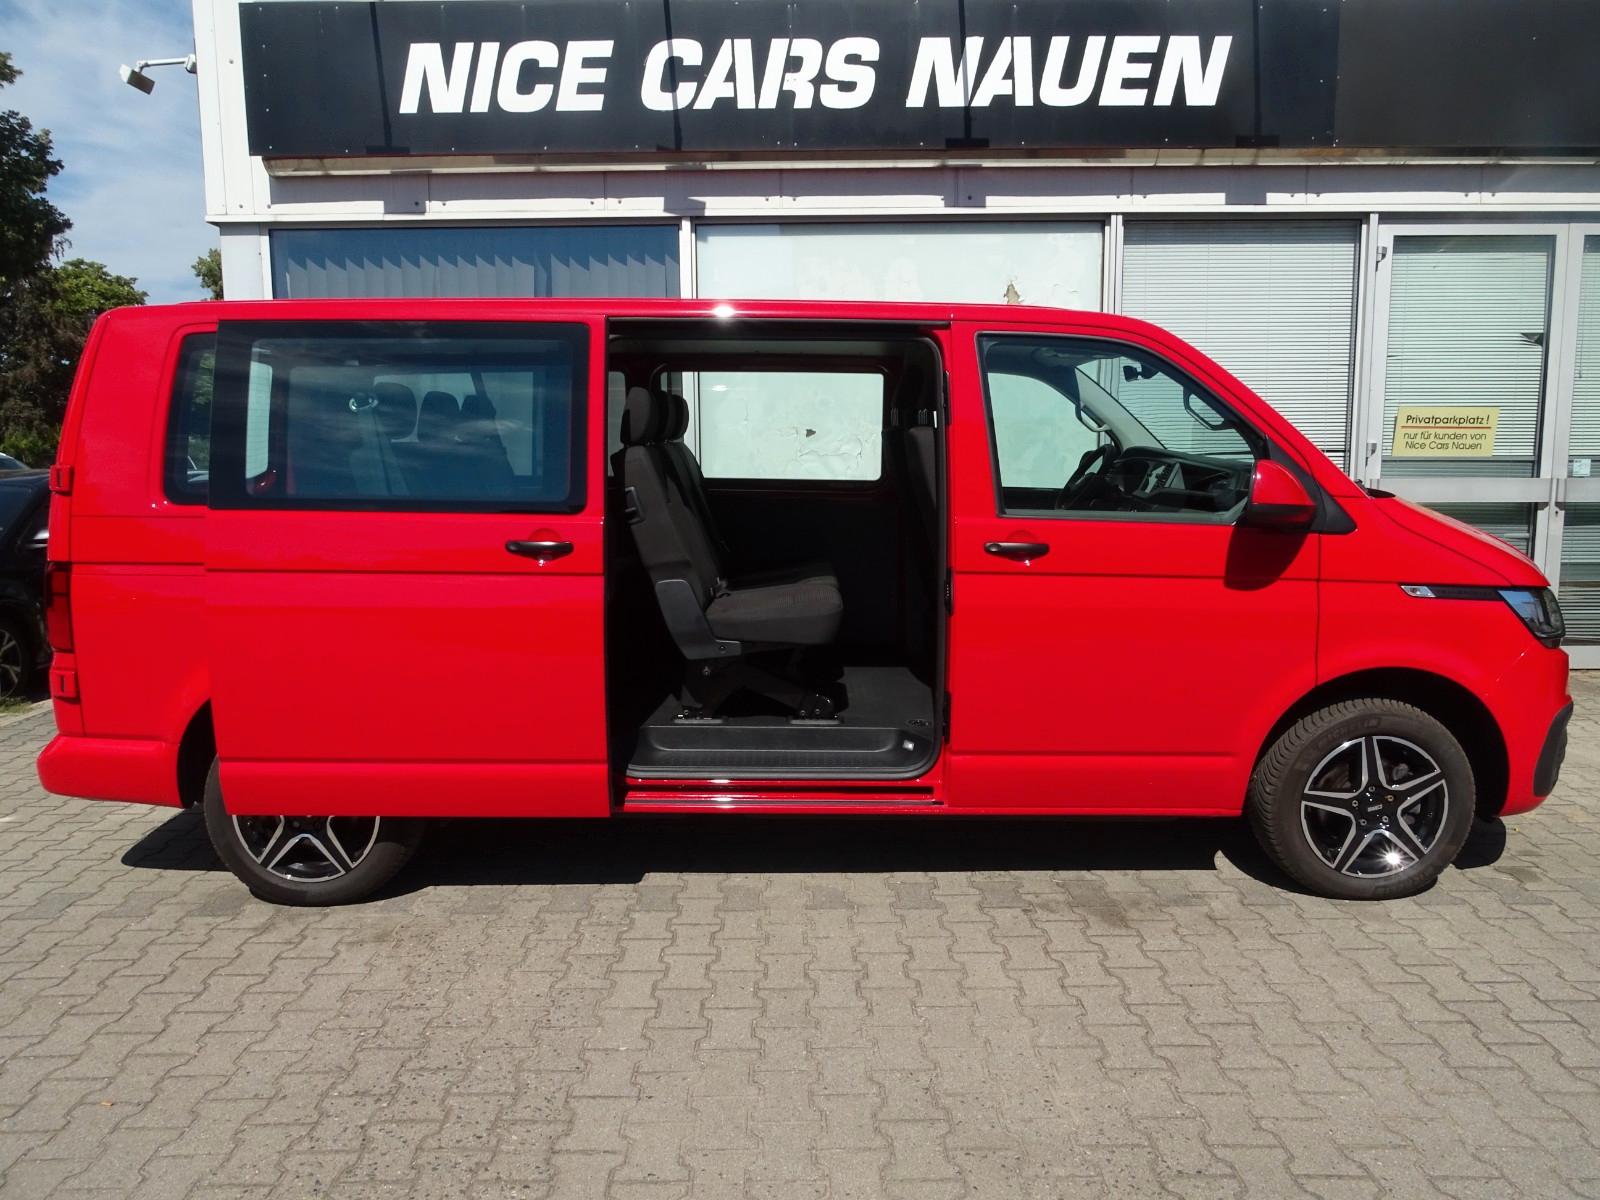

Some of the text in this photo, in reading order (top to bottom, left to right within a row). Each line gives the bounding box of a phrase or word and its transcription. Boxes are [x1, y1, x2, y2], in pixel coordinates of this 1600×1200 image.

[399, 36, 1232, 113] NICE CARS NAUEN
[1405, 414, 1484, 426] Privatparkplatz
[1403, 431, 1487, 441] nur für kunden von
[1405, 441, 1482, 450] Nice Cars Nauen
